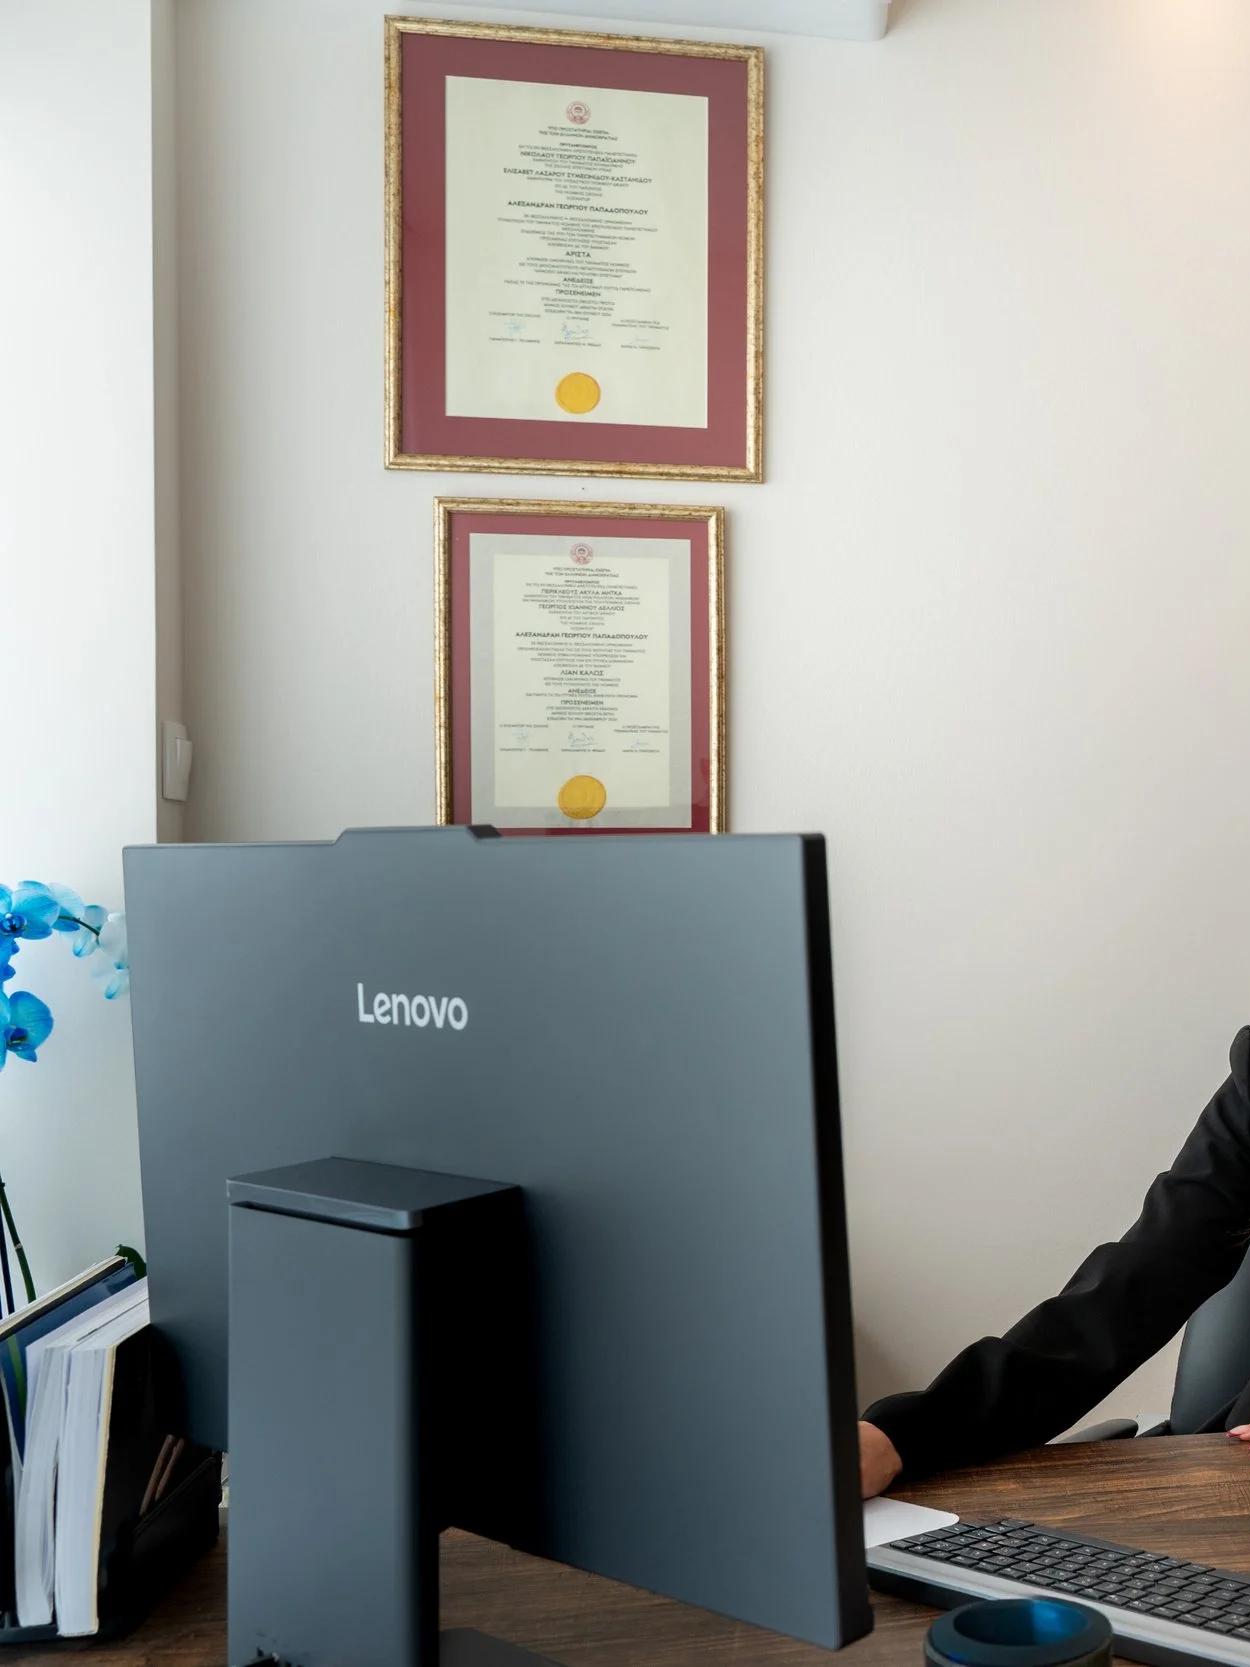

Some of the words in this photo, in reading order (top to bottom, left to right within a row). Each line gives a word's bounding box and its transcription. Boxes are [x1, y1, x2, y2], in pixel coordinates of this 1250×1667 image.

[508, 200, 555, 208] ΑΛΕΞΑΝΔΡΑΝ
[556, 203, 588, 211] ΓΕΩΡΓΙΟΥ
[590, 206, 648, 215] ΠΑΠΑΔΟΠΟΥΛΟΥ
[565, 250, 591, 258] ΑΡΙΣΤΑ
[357, 982, 469, 1031] Lenovo
